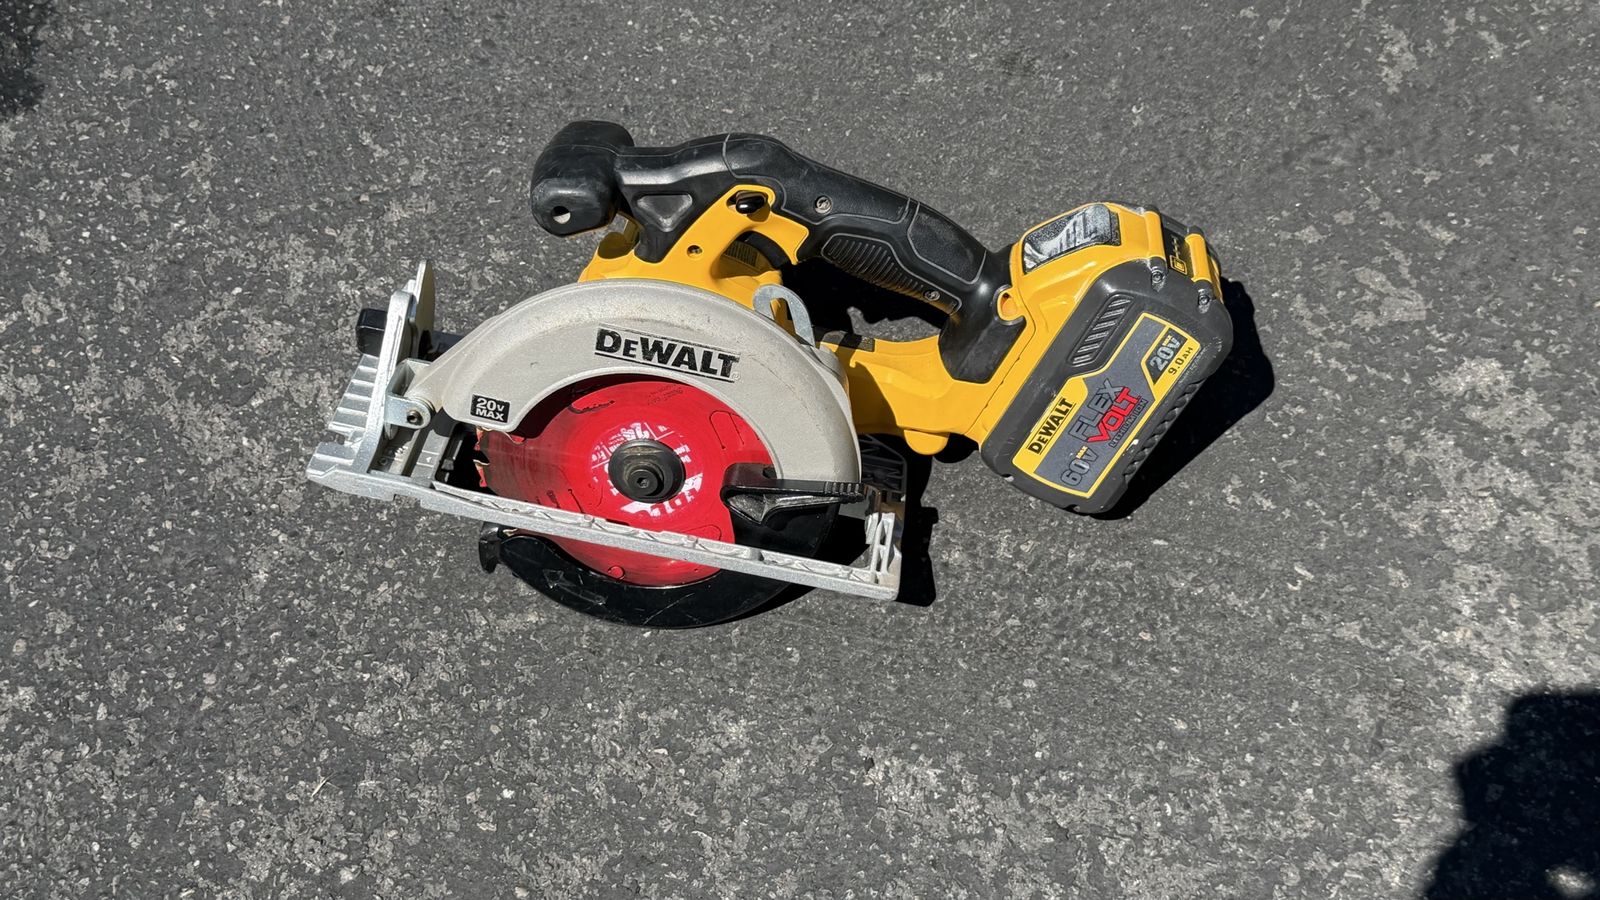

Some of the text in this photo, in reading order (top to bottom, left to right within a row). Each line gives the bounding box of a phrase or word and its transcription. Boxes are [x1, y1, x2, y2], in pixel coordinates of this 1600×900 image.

[1151, 337, 1182, 373] 20V
[475, 407, 505, 422] MAX
[1069, 378, 1124, 441] FLEX
[1087, 387, 1141, 443] VOLT
[1060, 449, 1099, 486] 60V
